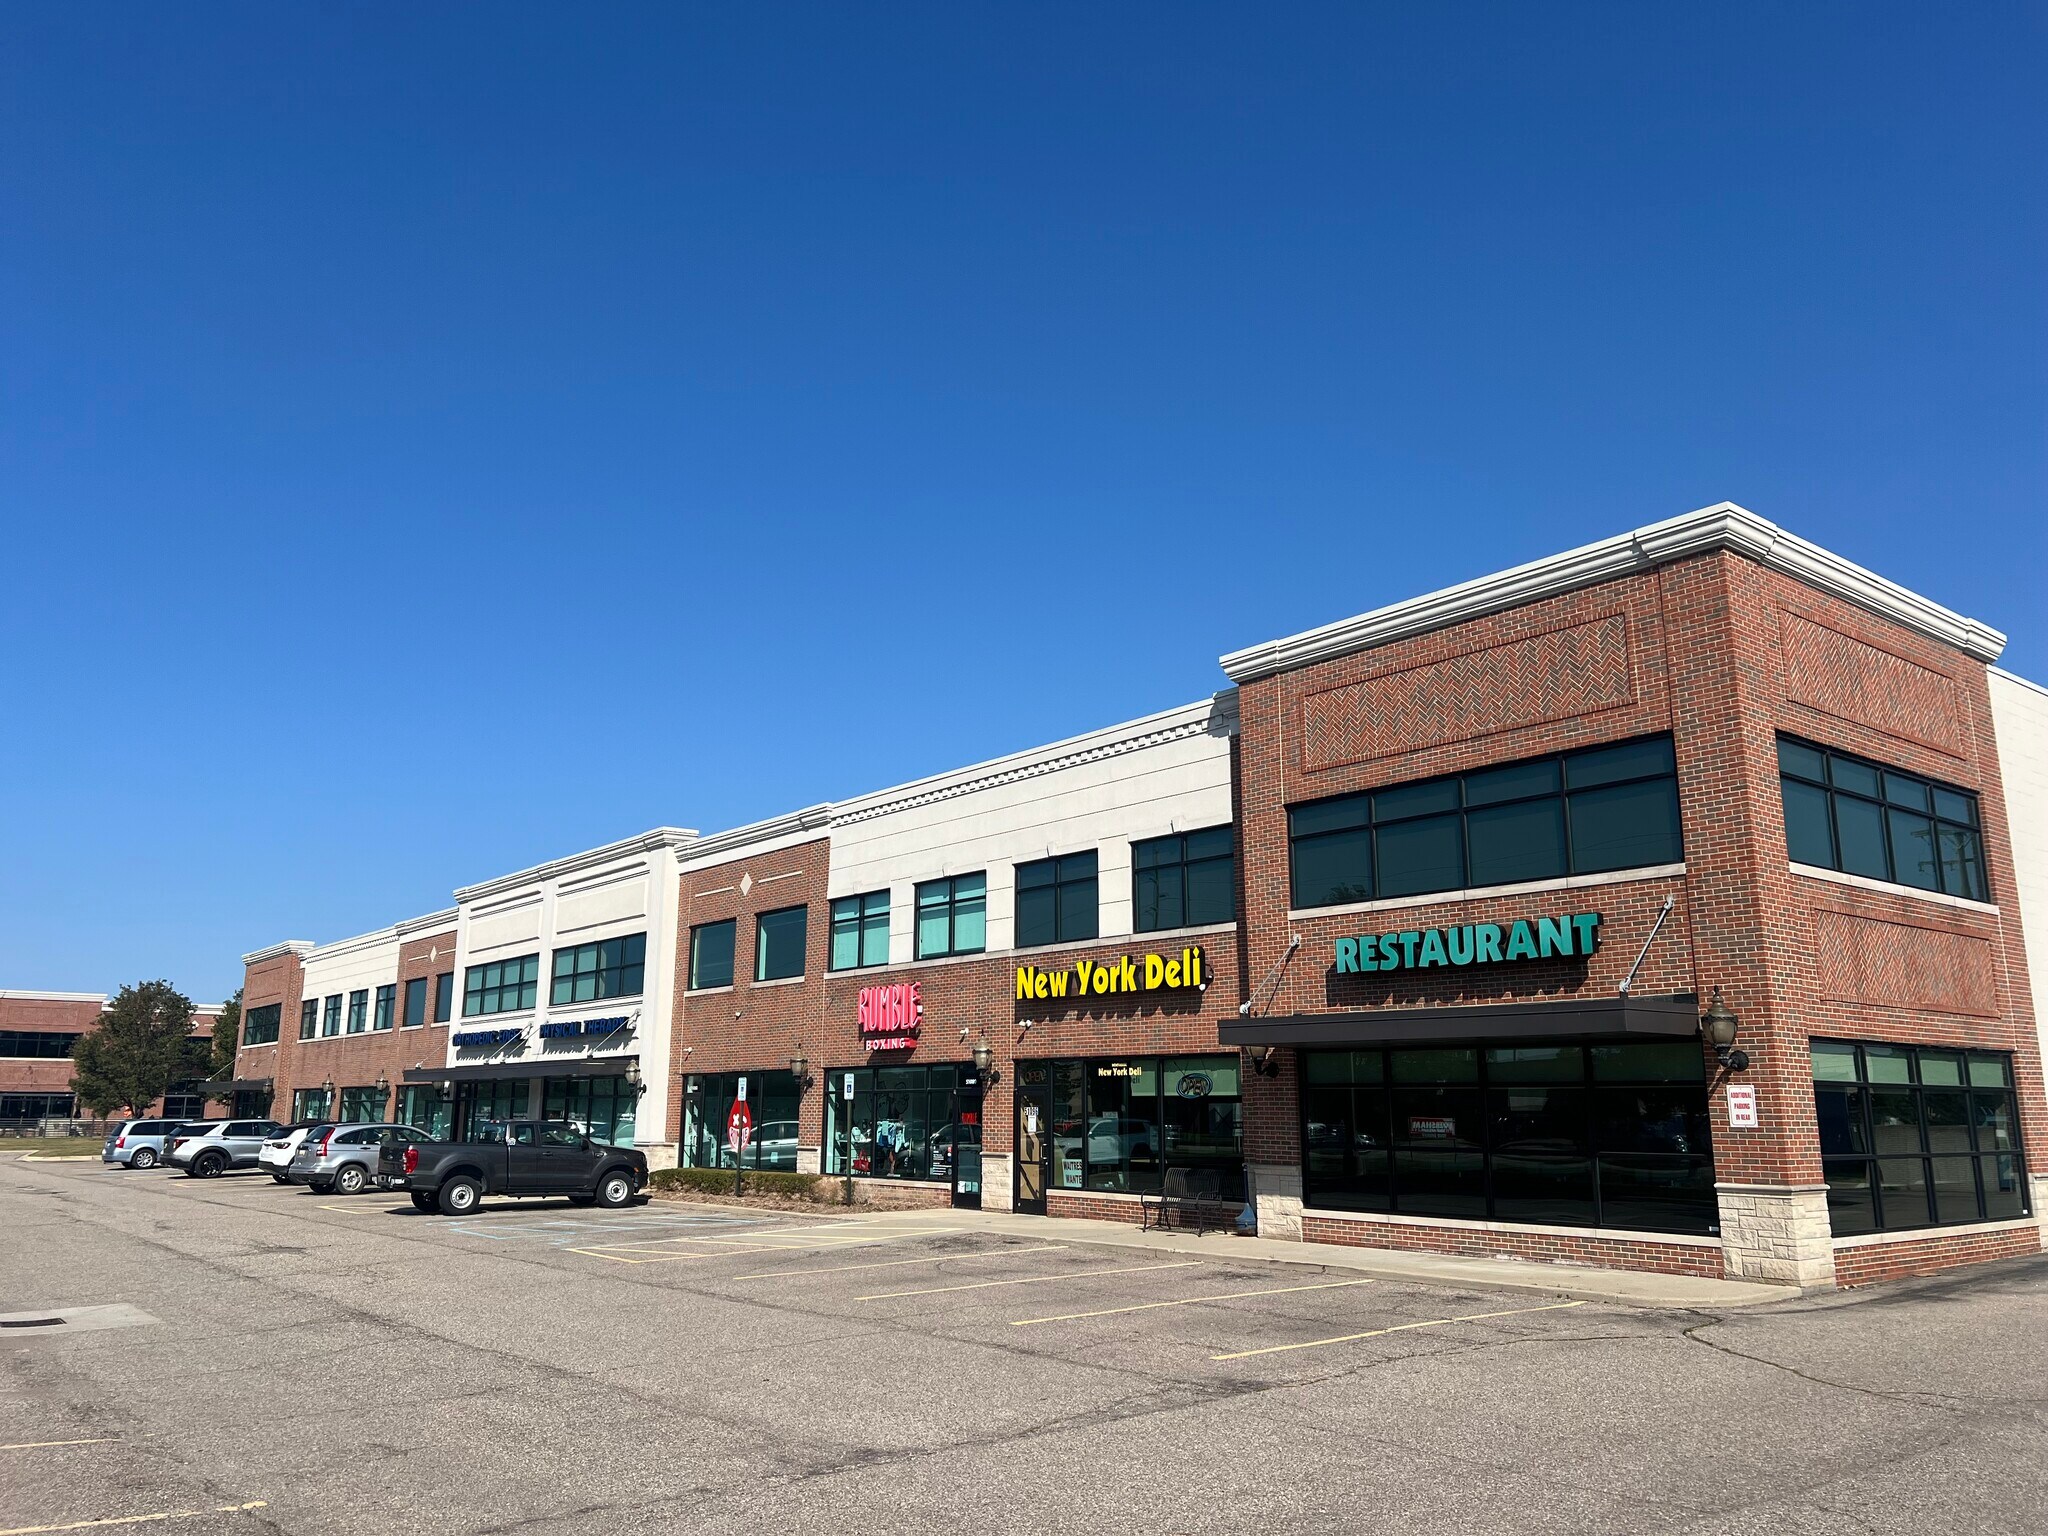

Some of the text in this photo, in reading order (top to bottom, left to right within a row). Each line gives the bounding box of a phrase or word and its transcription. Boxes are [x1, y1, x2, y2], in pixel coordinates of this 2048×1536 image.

[1335, 913, 1599, 973] RESTAURANT
[1016, 946, 1200, 1000] New York Deli
[858, 981, 922, 1032] RUMBLE
[540, 1017, 628, 1038] PHYSICAL THERAPY
[866, 1038, 906, 1051] BOXING
[1098, 1066, 1142, 1077] New York Deli
